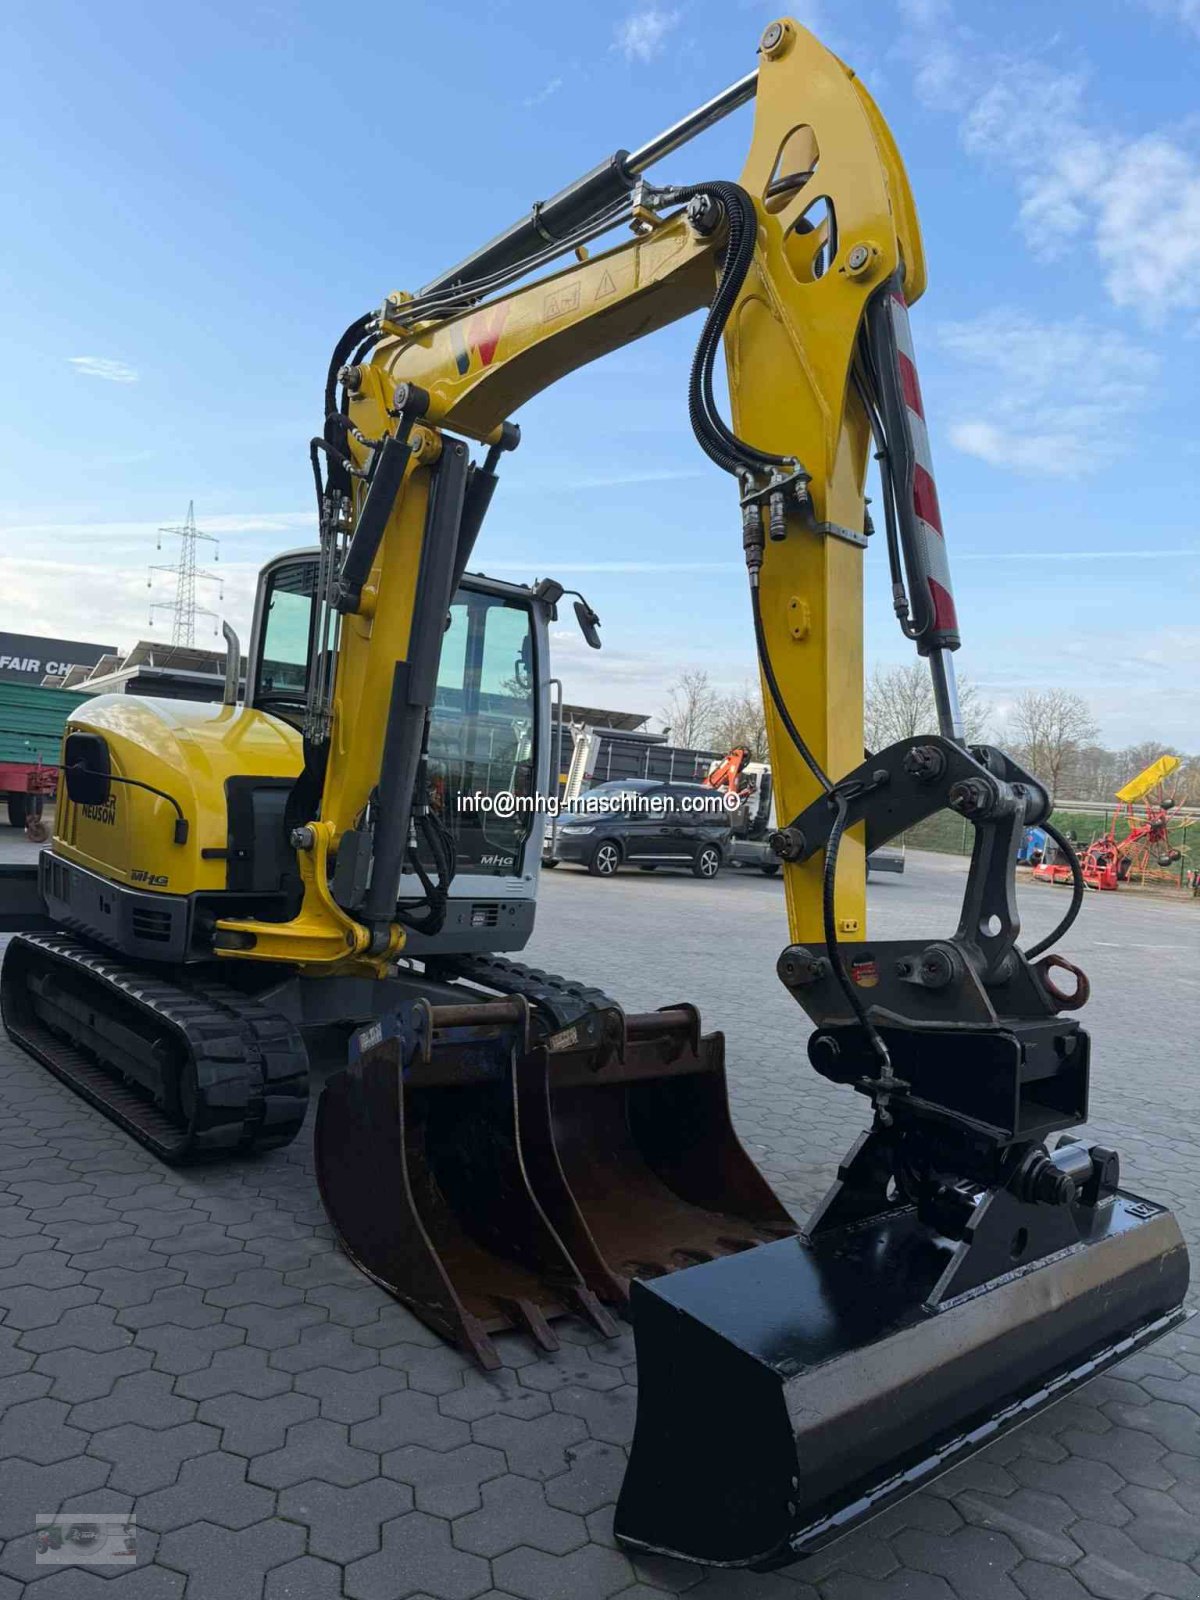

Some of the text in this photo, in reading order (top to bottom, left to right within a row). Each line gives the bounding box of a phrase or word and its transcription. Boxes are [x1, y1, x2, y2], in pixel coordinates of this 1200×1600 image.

[0, 656, 41, 673] FAIR
[81, 803, 116, 826] NEUSON
[480, 854, 514, 867] MHG
